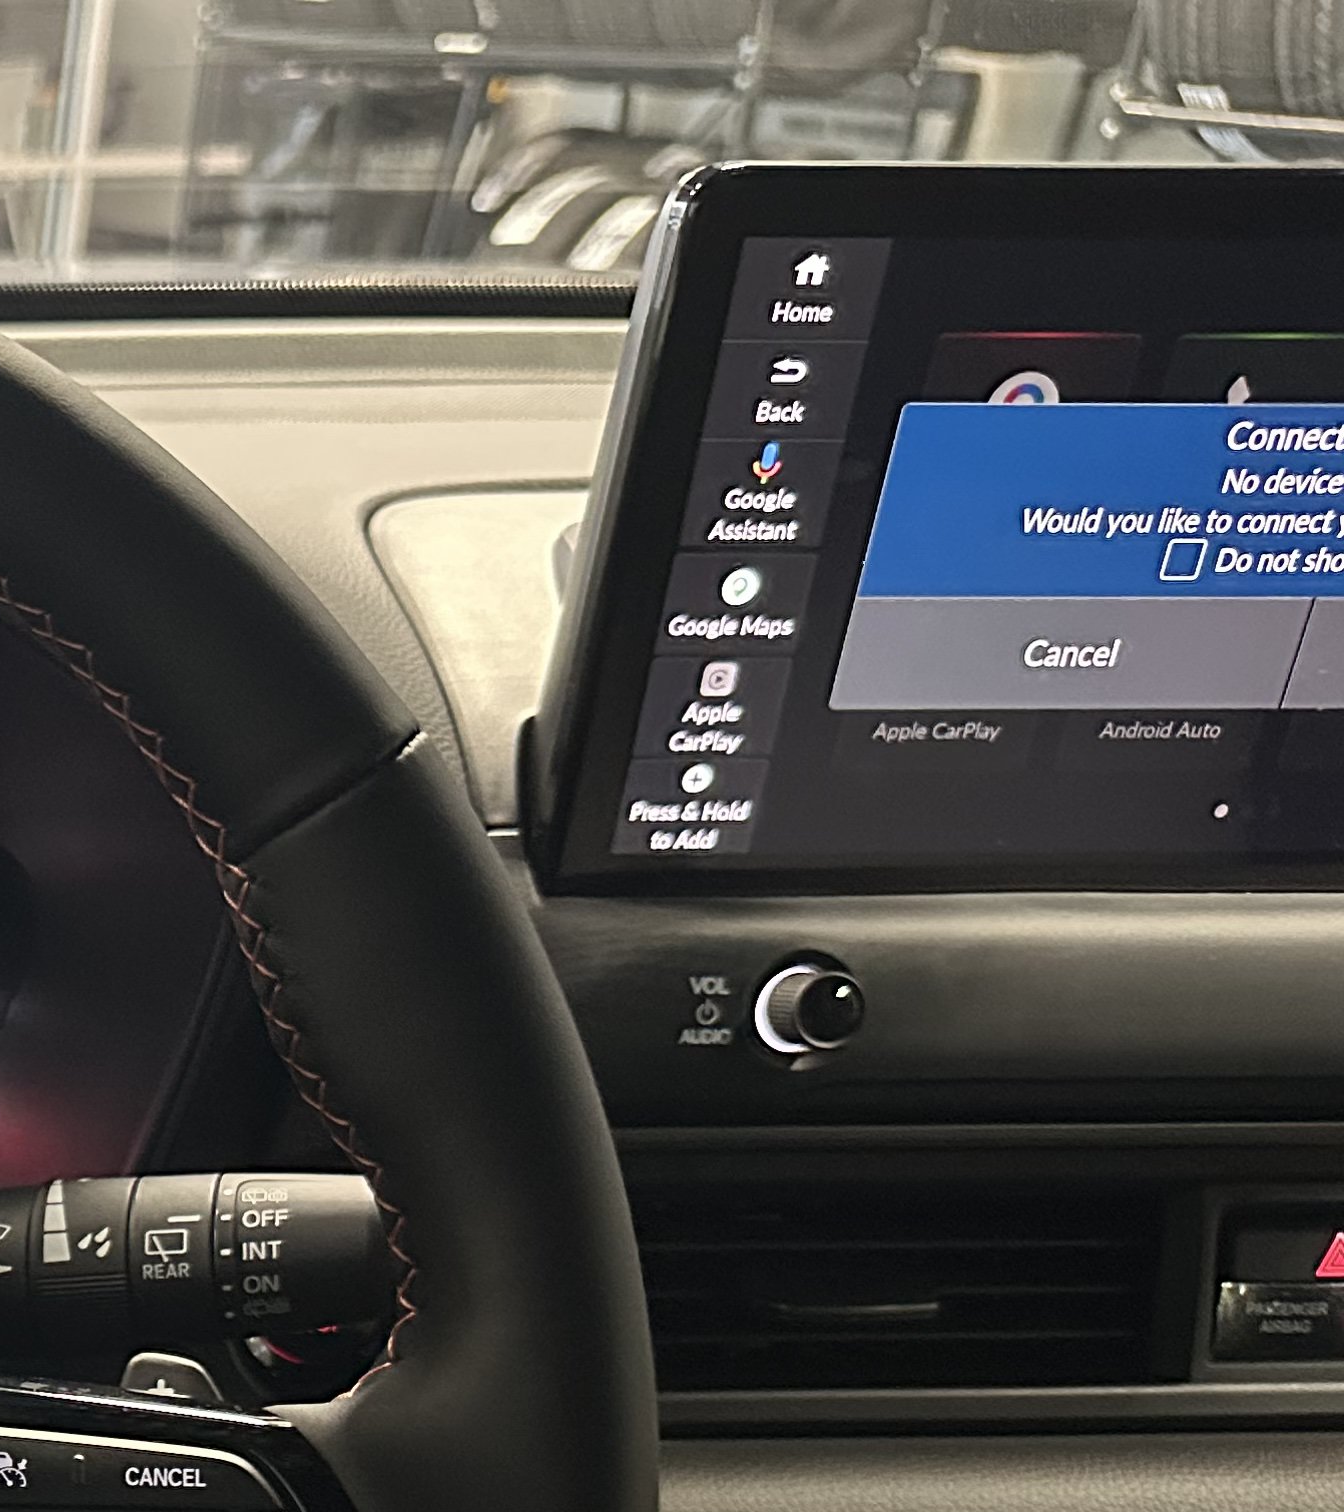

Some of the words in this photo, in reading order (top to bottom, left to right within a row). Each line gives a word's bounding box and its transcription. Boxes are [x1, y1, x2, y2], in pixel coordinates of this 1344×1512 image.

[770, 301, 834, 324] Home
[754, 400, 806, 424] Back
[1221, 468, 1260, 495] No
[1263, 467, 1344, 495] device
[723, 487, 797, 513] Google
[707, 518, 799, 542] Assistant
[1022, 506, 1101, 534] Would
[1106, 513, 1154, 539] you
[1157, 508, 1200, 534] like
[1206, 511, 1232, 534] to
[1236, 509, 1336, 534] connect
[1214, 547, 1254, 574] Do
[1256, 549, 1301, 574] not
[667, 615, 738, 640] Google
[739, 616, 795, 640] Maps
[1022, 638, 1121, 669] Cancel
[681, 702, 744, 726] Apple
[872, 722, 927, 742] Apple
[932, 722, 1002, 742] CarPlay
[1098, 721, 1173, 740] Android
[1176, 722, 1222, 740] Auto
[667, 731, 745, 755] CarPlay
[628, 801, 679, 822] Press
[680, 802, 700, 822] &
[700, 800, 752, 822] Hold
[650, 830, 671, 850] to
[673, 828, 719, 850] Add
[688, 976, 732, 996] VOL
[678, 1028, 733, 1045] AUDIO
[241, 1209, 289, 1229] OFF
[241, 1240, 282, 1260] INT
[141, 1262, 191, 1281] REAR
[242, 1274, 280, 1295] ON
[124, 1467, 207, 1488] CANCEL
